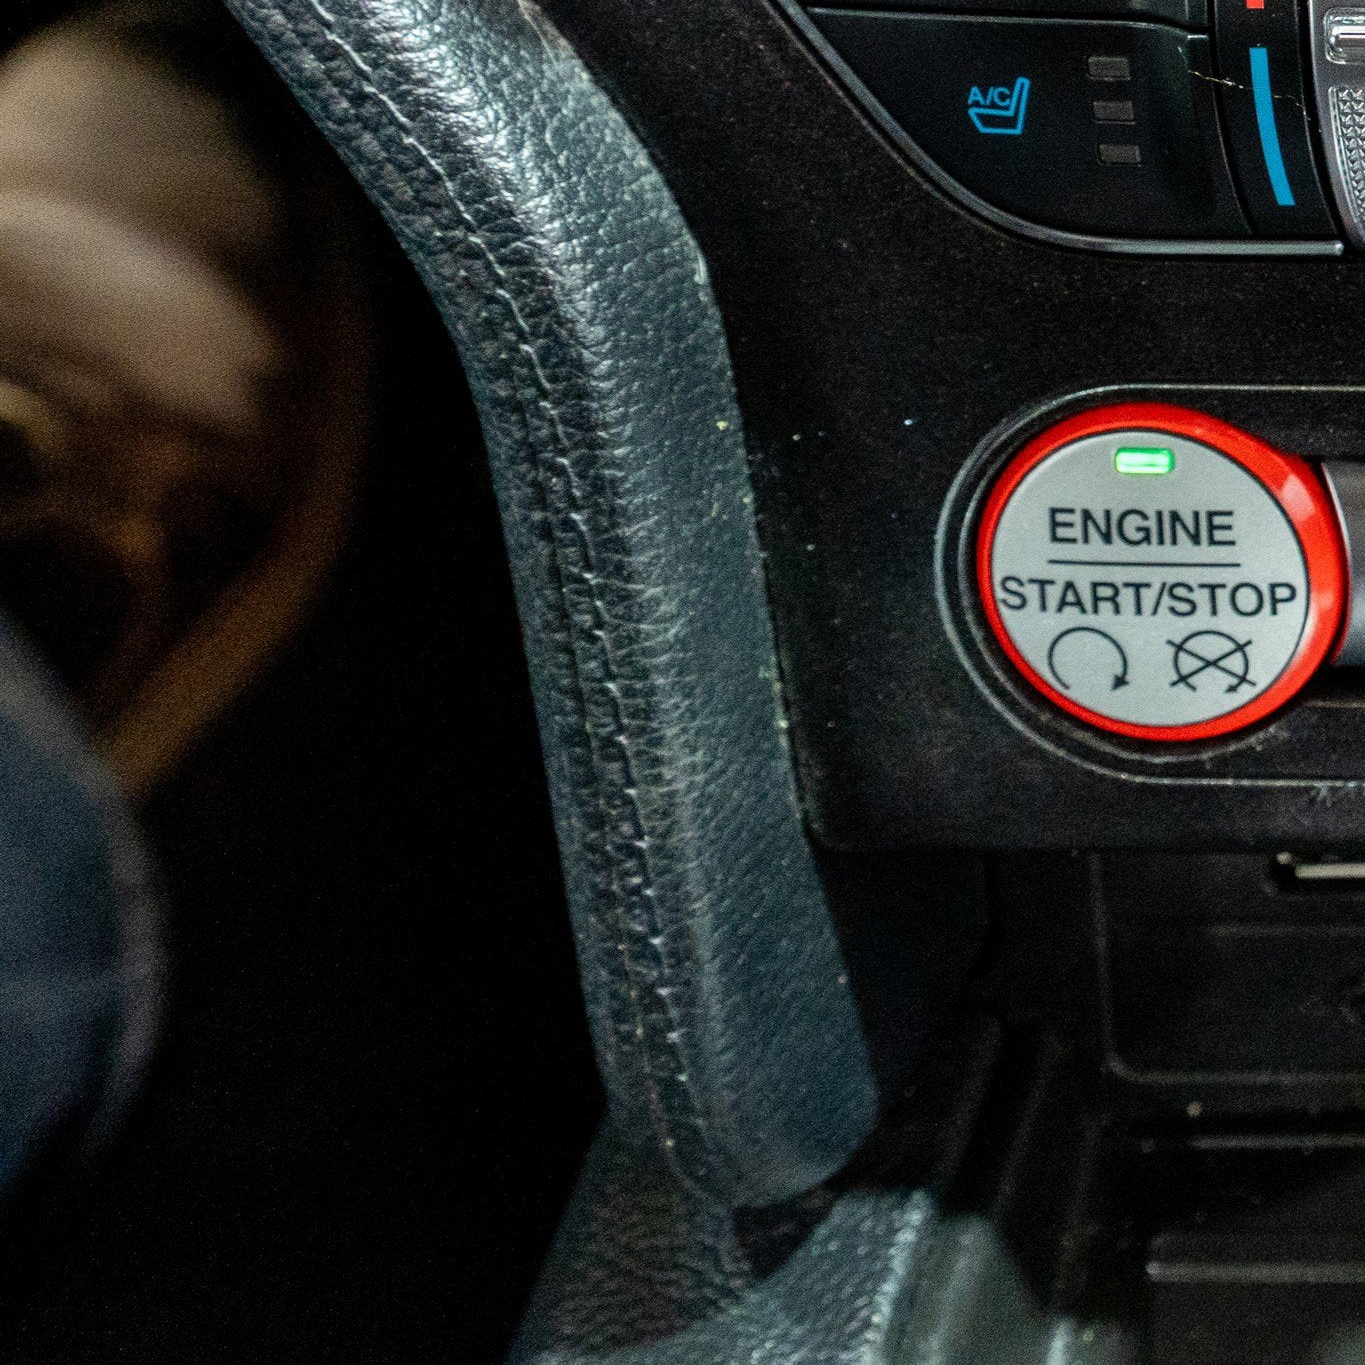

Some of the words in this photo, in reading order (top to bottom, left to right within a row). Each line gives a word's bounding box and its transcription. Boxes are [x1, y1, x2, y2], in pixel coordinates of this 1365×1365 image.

[967, 85, 1010, 107] A/C
[1047, 506, 1238, 547] ENGINE
[999, 576, 1298, 619] START/STOP
